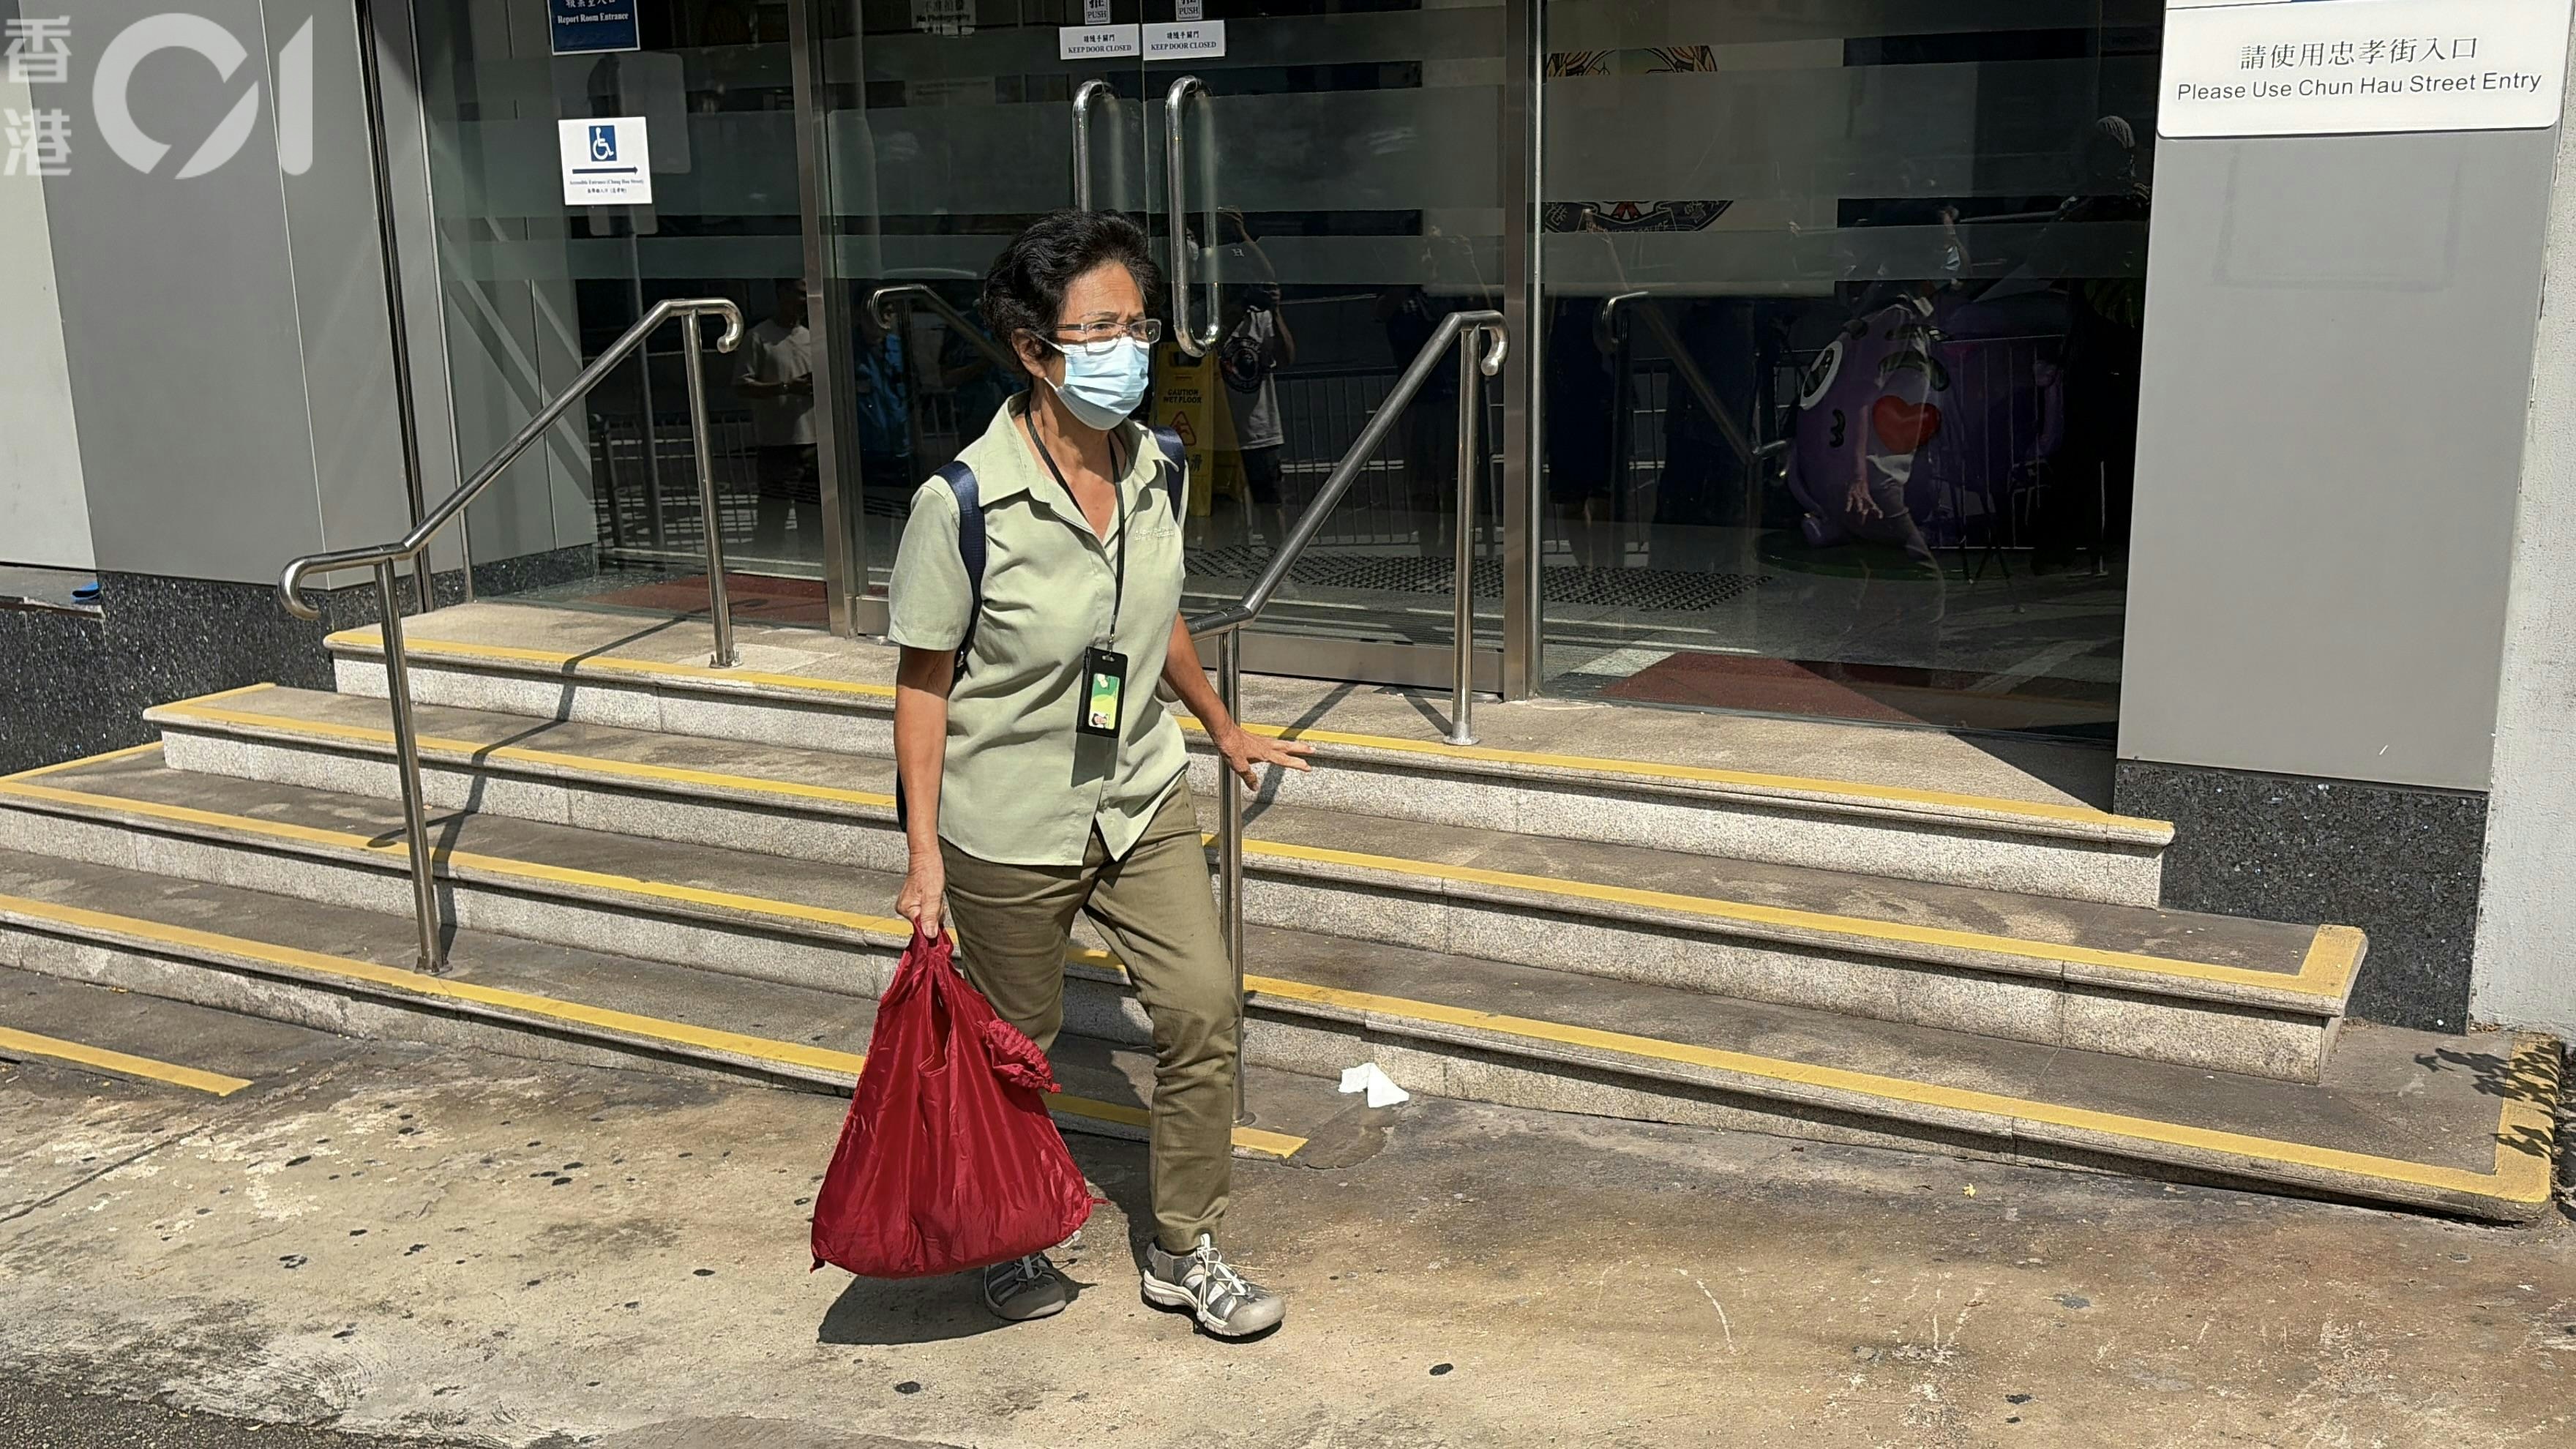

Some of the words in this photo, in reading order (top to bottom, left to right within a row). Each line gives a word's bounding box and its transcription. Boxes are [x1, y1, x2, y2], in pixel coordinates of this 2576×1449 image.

[1087, 10, 1107, 19] PUSH
[1179, 7, 1199, 15] PUSH
[558, 15, 580, 25] Report
[580, 14, 599, 22] Room
[600, 12, 629, 21] Entrance
[1189, 41, 1216, 49] CLOSED
[2241, 37, 2477, 70] 請使用忠孝街入口
[2178, 83, 2246, 100] Please
[2253, 81, 2292, 97] Use
[2299, 79, 2353, 96] Chun
[2360, 77, 2403, 94] Hau
[2409, 74, 2476, 92] Street
[2482, 72, 2542, 93] Entry
